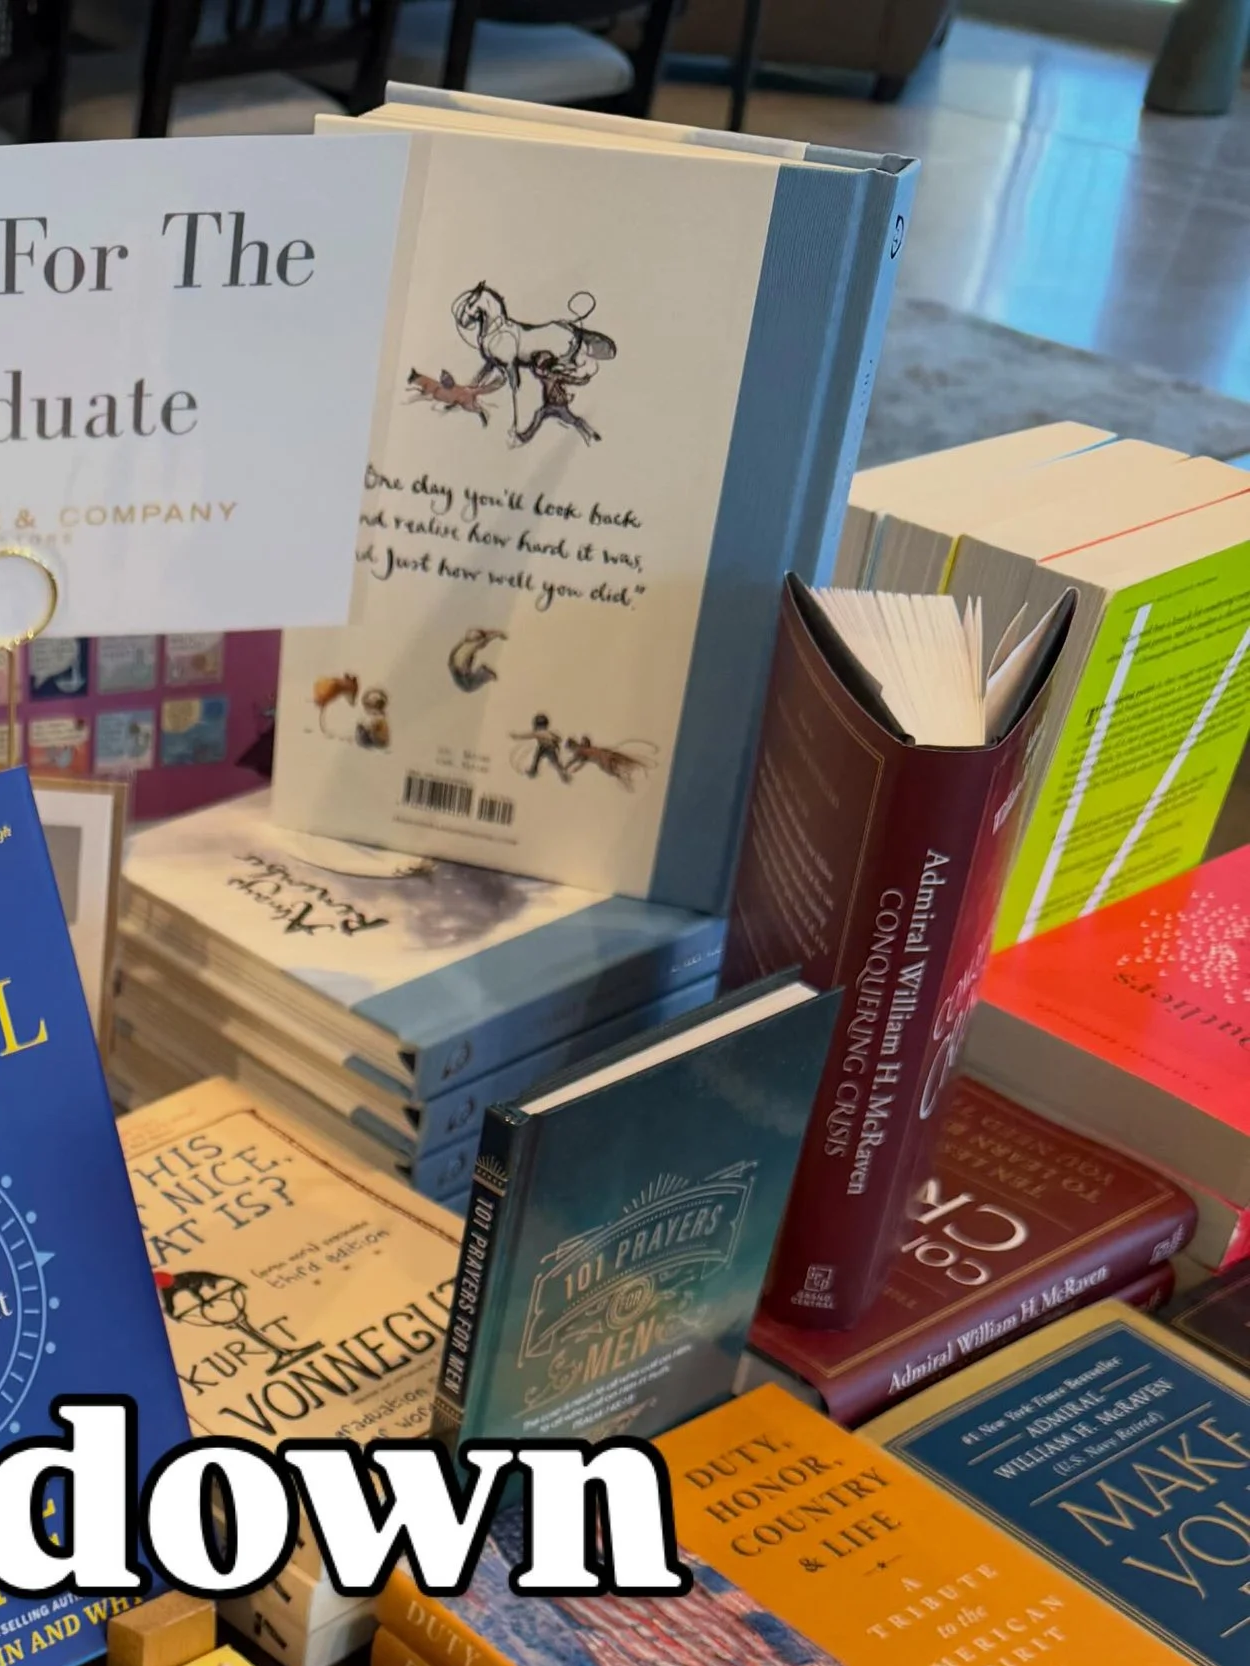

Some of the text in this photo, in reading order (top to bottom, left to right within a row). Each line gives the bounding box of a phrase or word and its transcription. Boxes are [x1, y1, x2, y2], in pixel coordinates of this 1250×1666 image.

[161, 210, 316, 291] The
[13, 508, 37, 530] &
[58, 501, 238, 528] COMPANY
[364, 464, 403, 490] One
[411, 474, 453, 515] day
[533, 494, 582, 520] look
[589, 502, 642, 529] back
[467, 522, 510, 547] how
[517, 530, 569, 560] hard
[577, 540, 594, 562] it
[437, 554, 583, 613] how well you
[823, 887, 905, 1158] CONQUERING CRISIS
[846, 848, 950, 1196] Admiral William H. McRaven
[213, 1176, 295, 1230] IS?
[563, 1203, 726, 1300] 101 PRAYERS
[443, 1196, 496, 1396] 101 PRAYERS FOR MEN
[888, 1264, 1111, 1395] Admiral William H. McRaven
[177, 1316, 301, 1397] KURT
[581, 1317, 656, 1385] MEN
[978, 1355, 1124, 1437] New York Times Bestseller
[993, 1376, 1175, 1480] WILLIAM H. McRAVEN
[1024, 1389, 1107, 1439] ADMIRAL
[684, 1432, 795, 1490] DUTY,
[1084, 1435, 1118, 1460] Navy
[704, 1453, 845, 1524] HONOR,
[730, 1466, 891, 1558] COUNTRY
[798, 1509, 902, 1573] & LIFE
[866, 1562, 999, 1640] TRIBUTE
[900, 1576, 924, 1593] A
[30, 1613, 82, 1655] AND
[936, 1603, 990, 1640] to the
